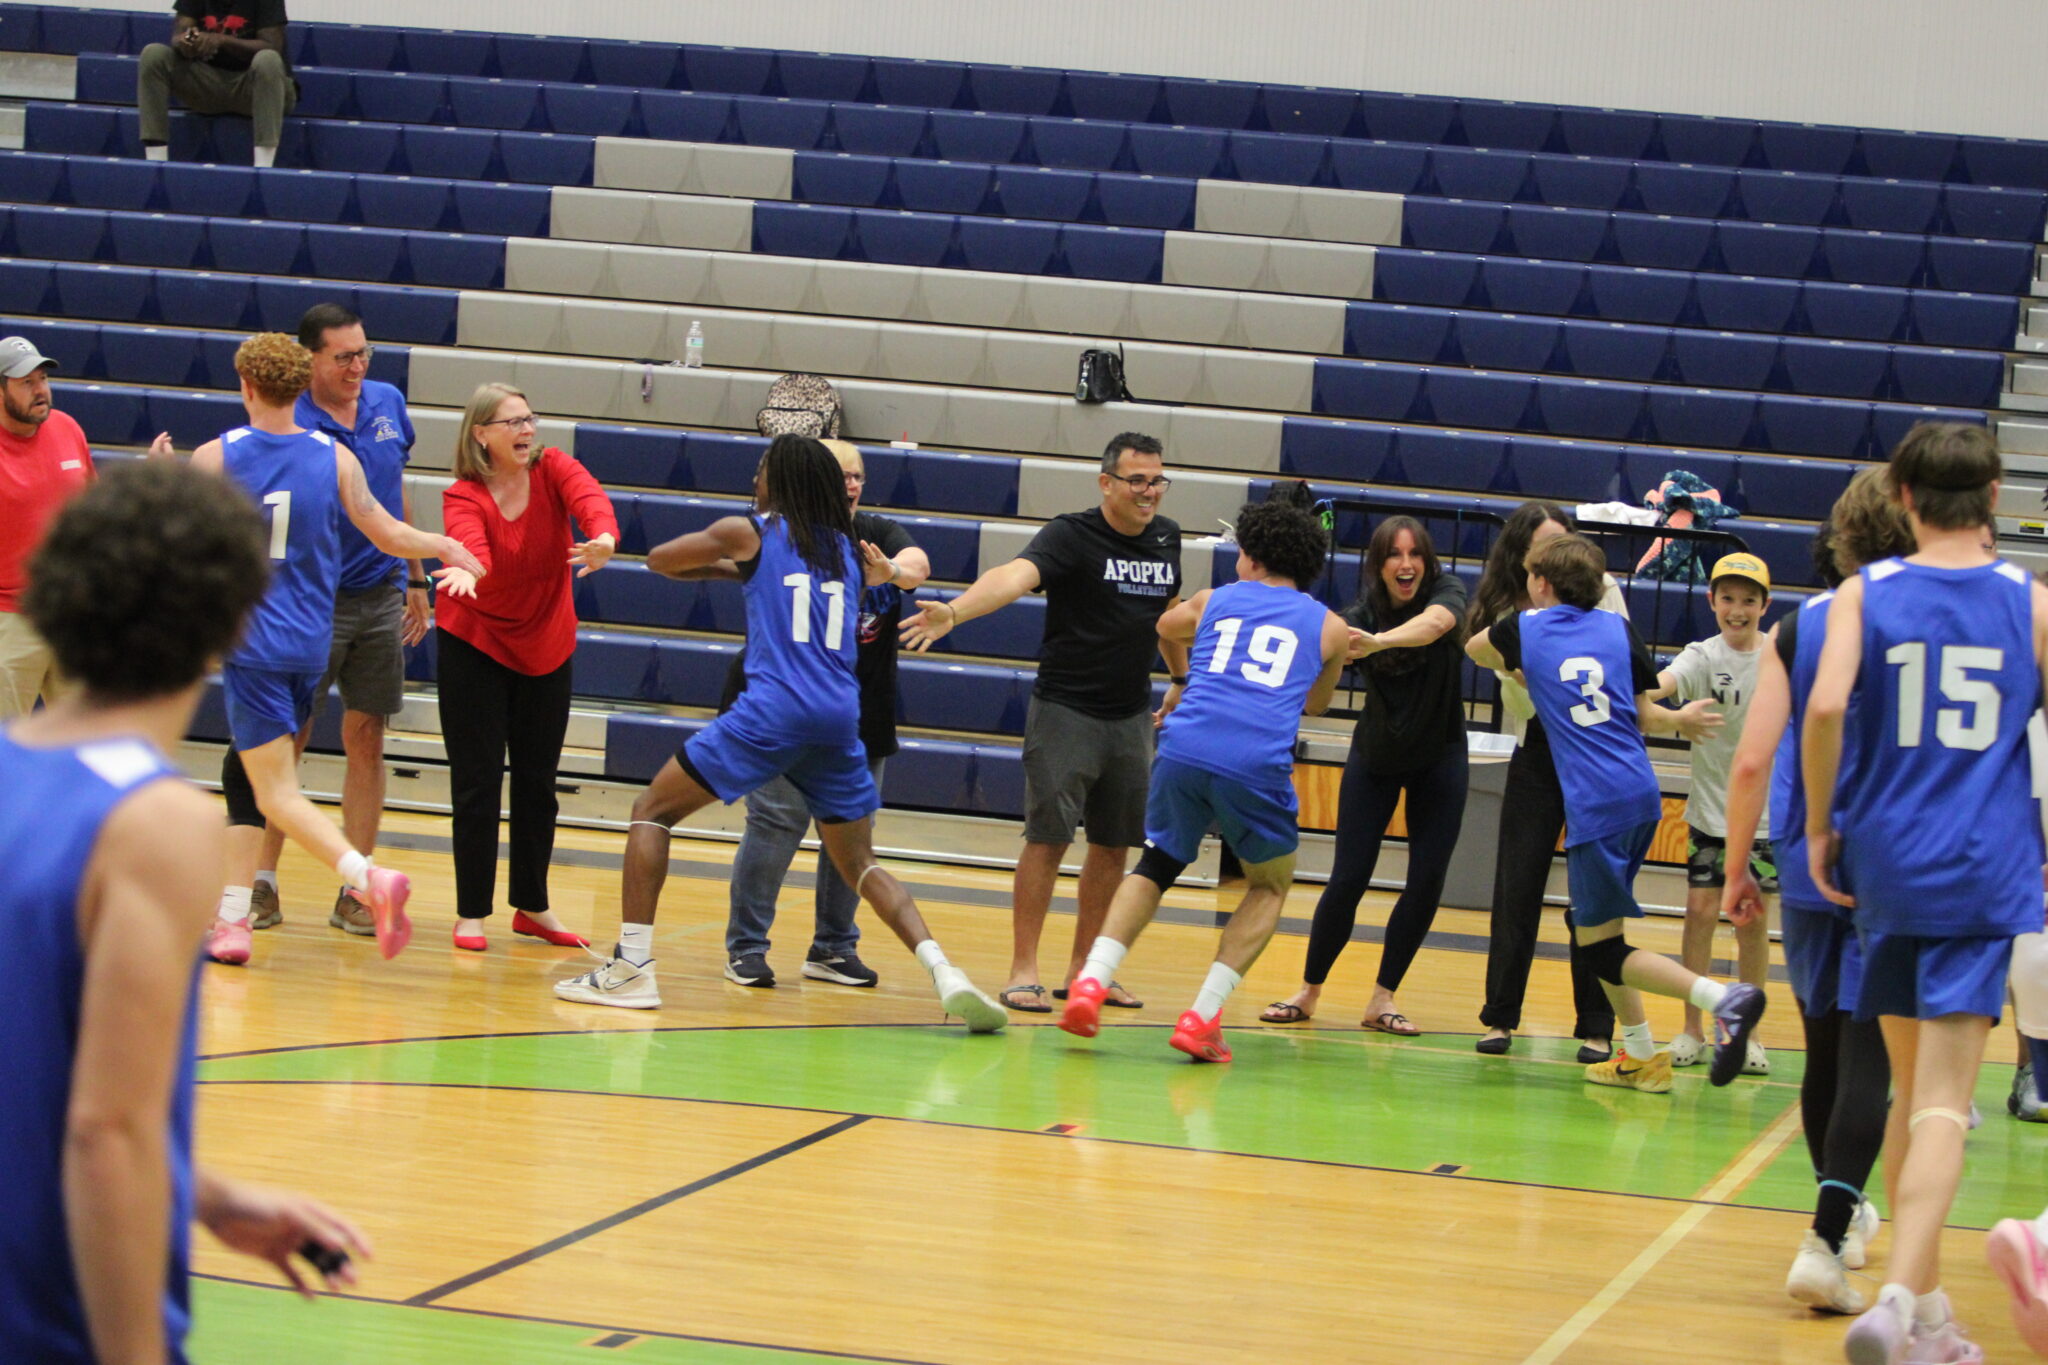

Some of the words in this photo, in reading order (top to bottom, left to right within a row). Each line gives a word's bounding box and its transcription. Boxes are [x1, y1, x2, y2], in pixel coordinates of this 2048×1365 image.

[264, 490, 291, 559] 1
[1104, 558, 1174, 584] APOPKA
[784, 573, 844, 650] 11
[1208, 617, 1299, 688] 19
[1559, 656, 1611, 727] 3
[1886, 642, 2004, 752] 15
